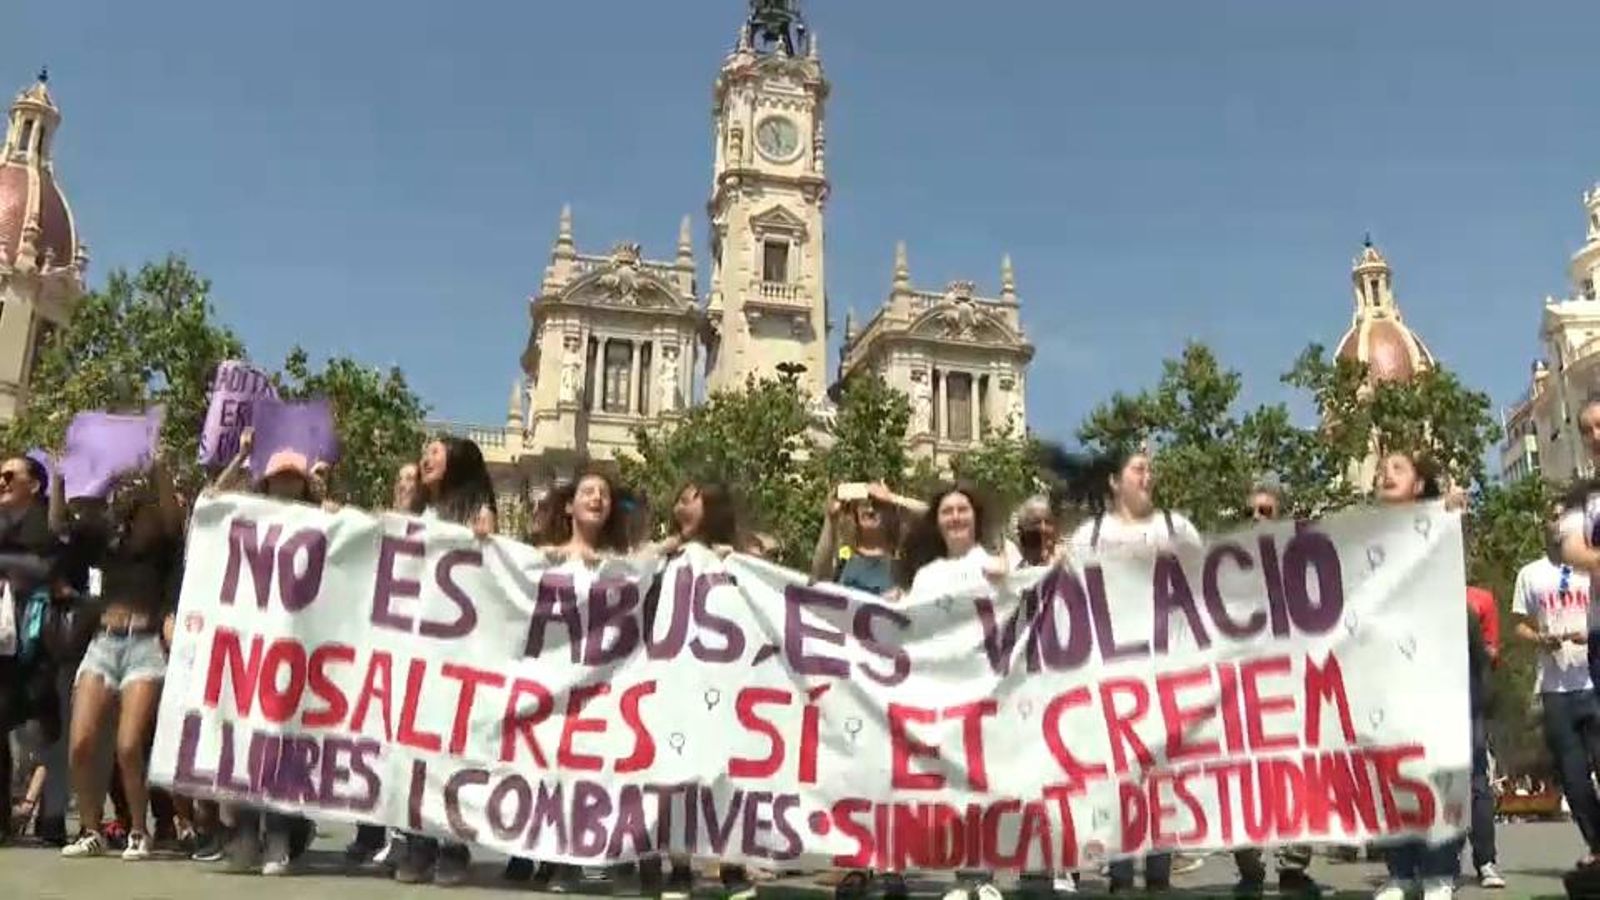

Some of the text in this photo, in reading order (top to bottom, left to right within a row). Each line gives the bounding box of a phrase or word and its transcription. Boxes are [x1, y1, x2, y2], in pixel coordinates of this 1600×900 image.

[219, 518, 328, 613] NO
[370, 521, 483, 638] ÉS
[203, 625, 1357, 792] NOSALTRES SÍ ET CREIEM
[173, 711, 382, 810] LLIURES
[408, 759, 427, 830] I
[444, 767, 803, 860] COMBATIVES
